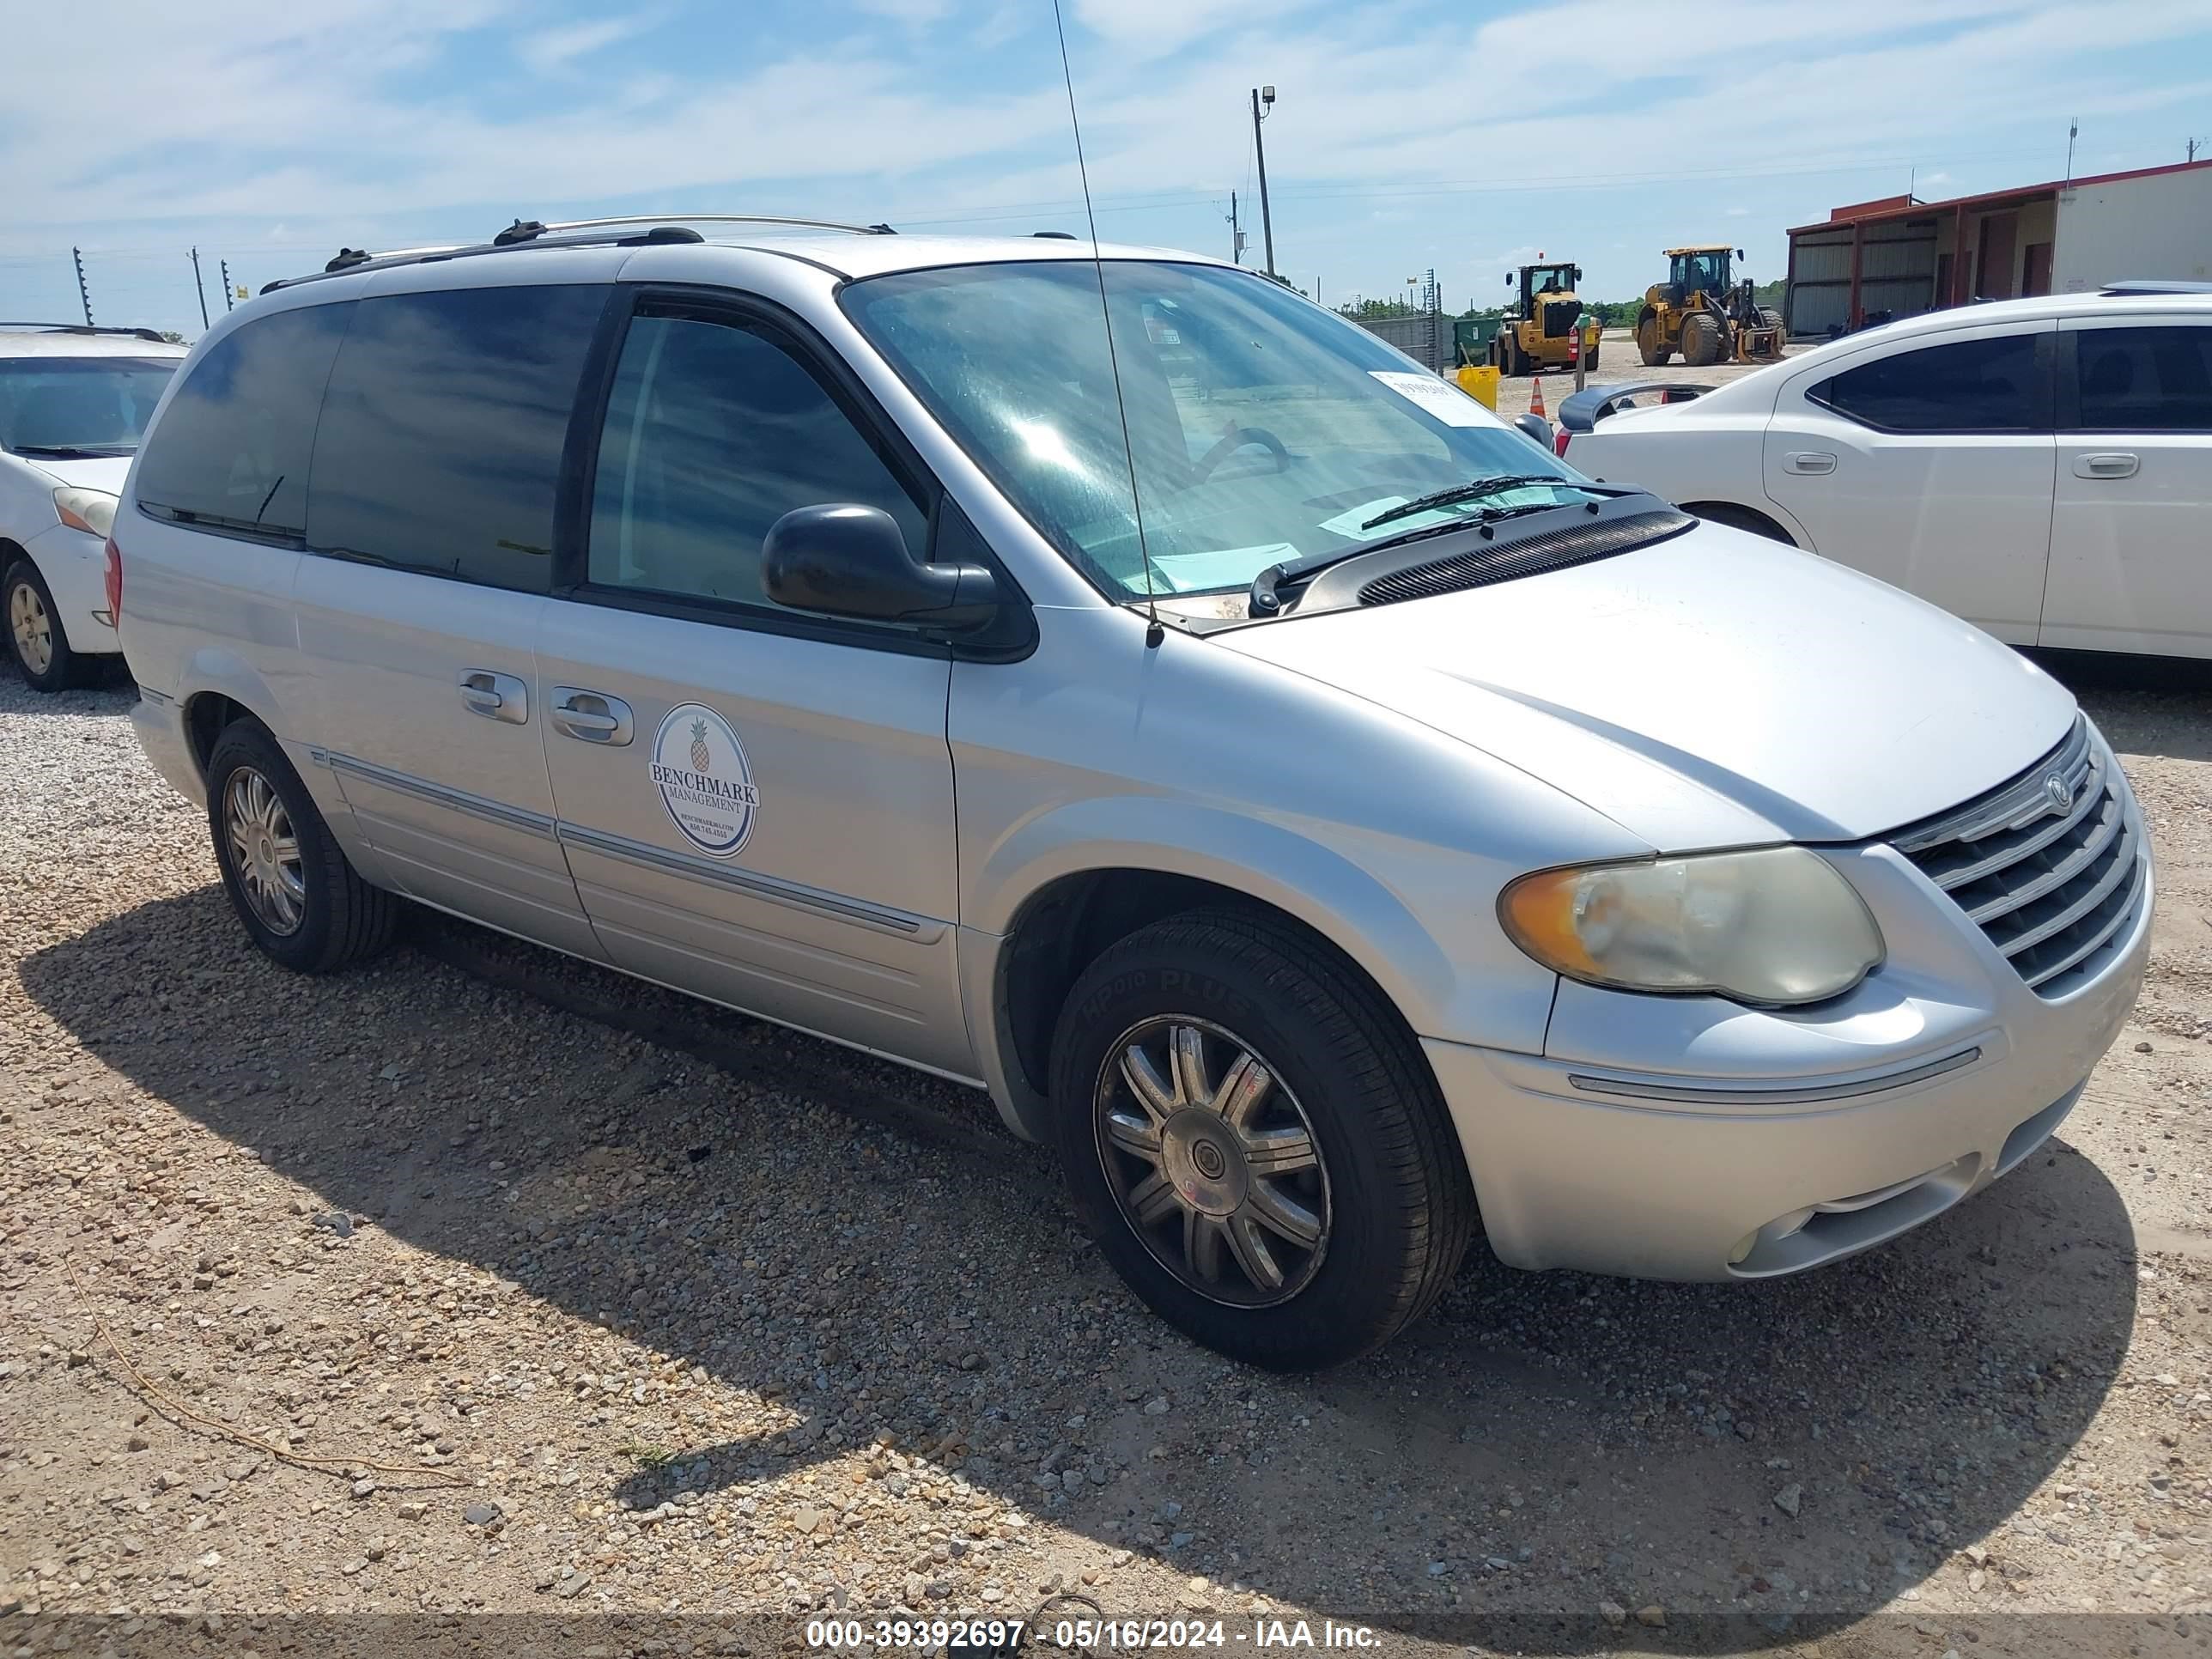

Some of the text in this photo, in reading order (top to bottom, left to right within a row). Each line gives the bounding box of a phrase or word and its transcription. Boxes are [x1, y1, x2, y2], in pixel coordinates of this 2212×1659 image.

[652, 764, 757, 805] BENCHMARK
[669, 786, 741, 814] MANAGEMENT
[1160, 968, 1252, 1017] PLUS
